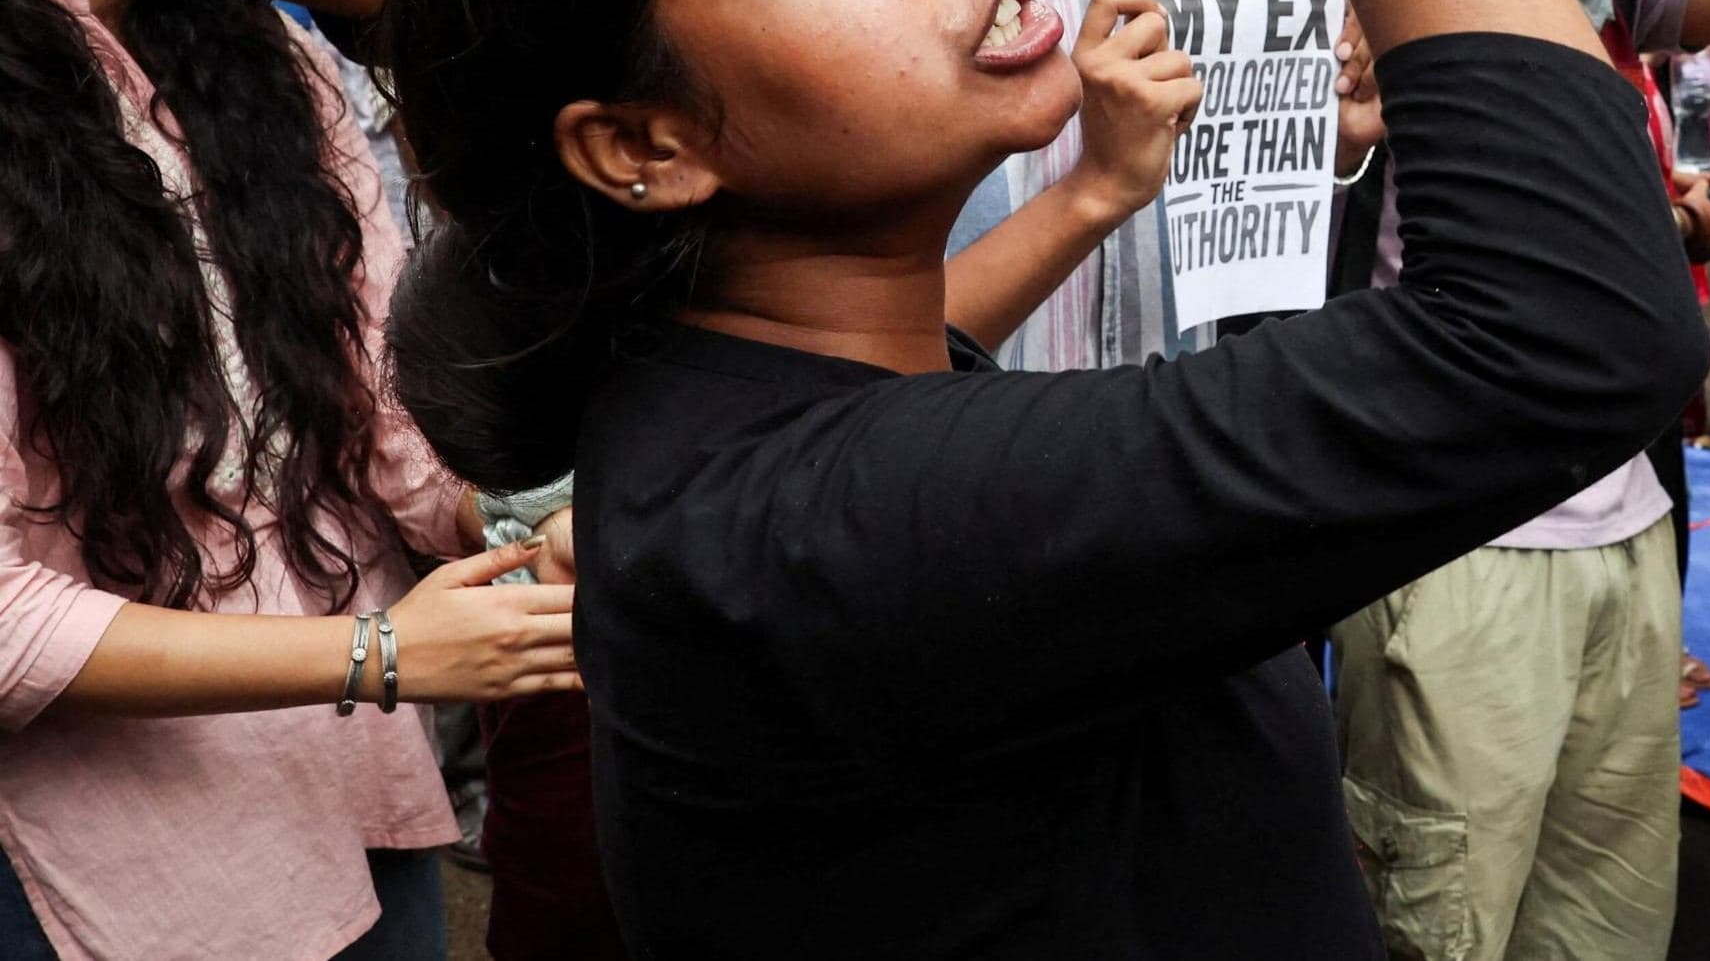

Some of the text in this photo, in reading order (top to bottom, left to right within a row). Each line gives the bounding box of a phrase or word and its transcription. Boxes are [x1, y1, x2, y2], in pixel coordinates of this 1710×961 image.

[1168, 116, 1327, 186] ORE THAN
[1210, 180, 1246, 204] THE
[1170, 200, 1321, 276] UTHORITY
